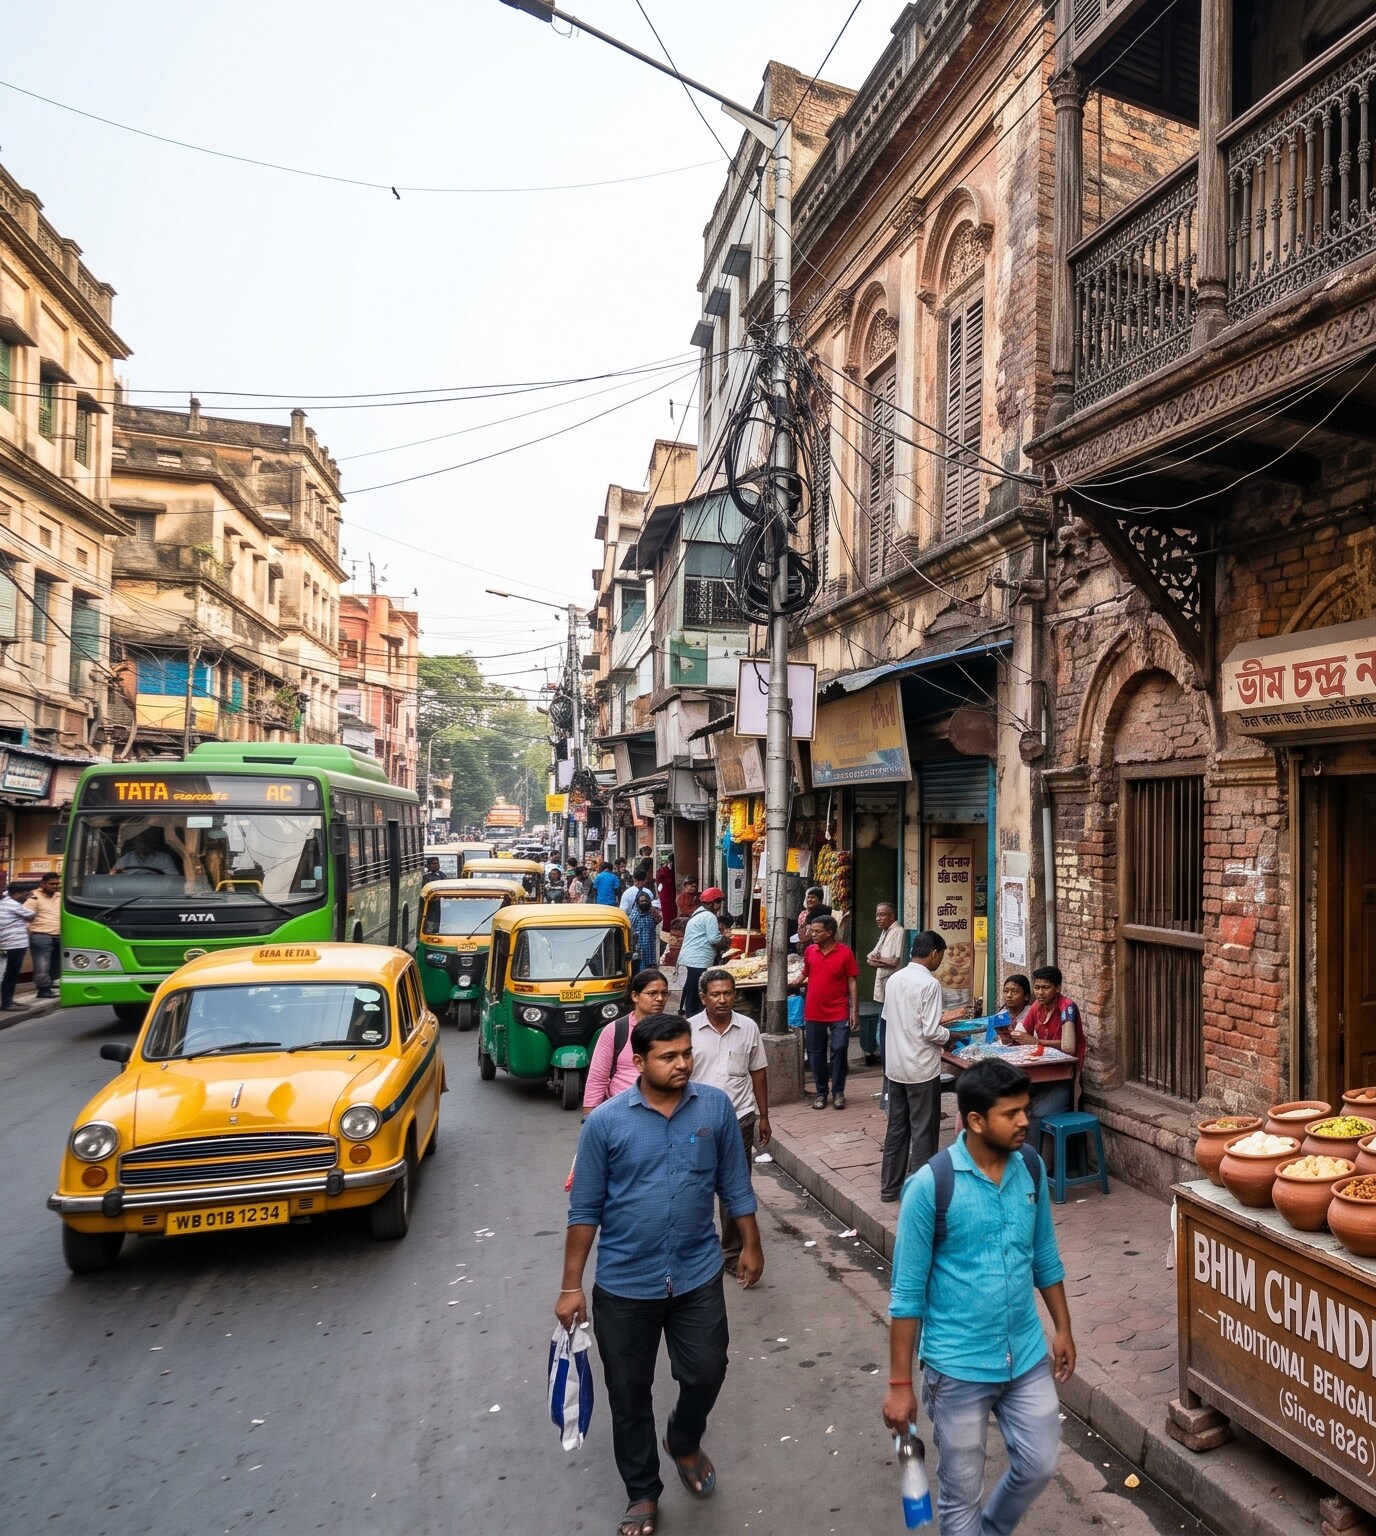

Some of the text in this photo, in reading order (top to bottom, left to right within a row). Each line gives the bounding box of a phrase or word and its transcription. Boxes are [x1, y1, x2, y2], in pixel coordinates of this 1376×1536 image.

[1235, 658, 1286, 705] ভীম
[1292, 655, 1349, 698] চন্দ্র
[115, 782, 169, 801] TATA
[266, 785, 293, 802] AC
[179, 913, 215, 922] TATA
[176, 1213, 202, 1230] WB
[1193, 1230, 1257, 1312] BHIM
[1217, 1309, 1310, 1388] TRADITIONAL
[1279, 1387, 1376, 1477] (Since 1826)
